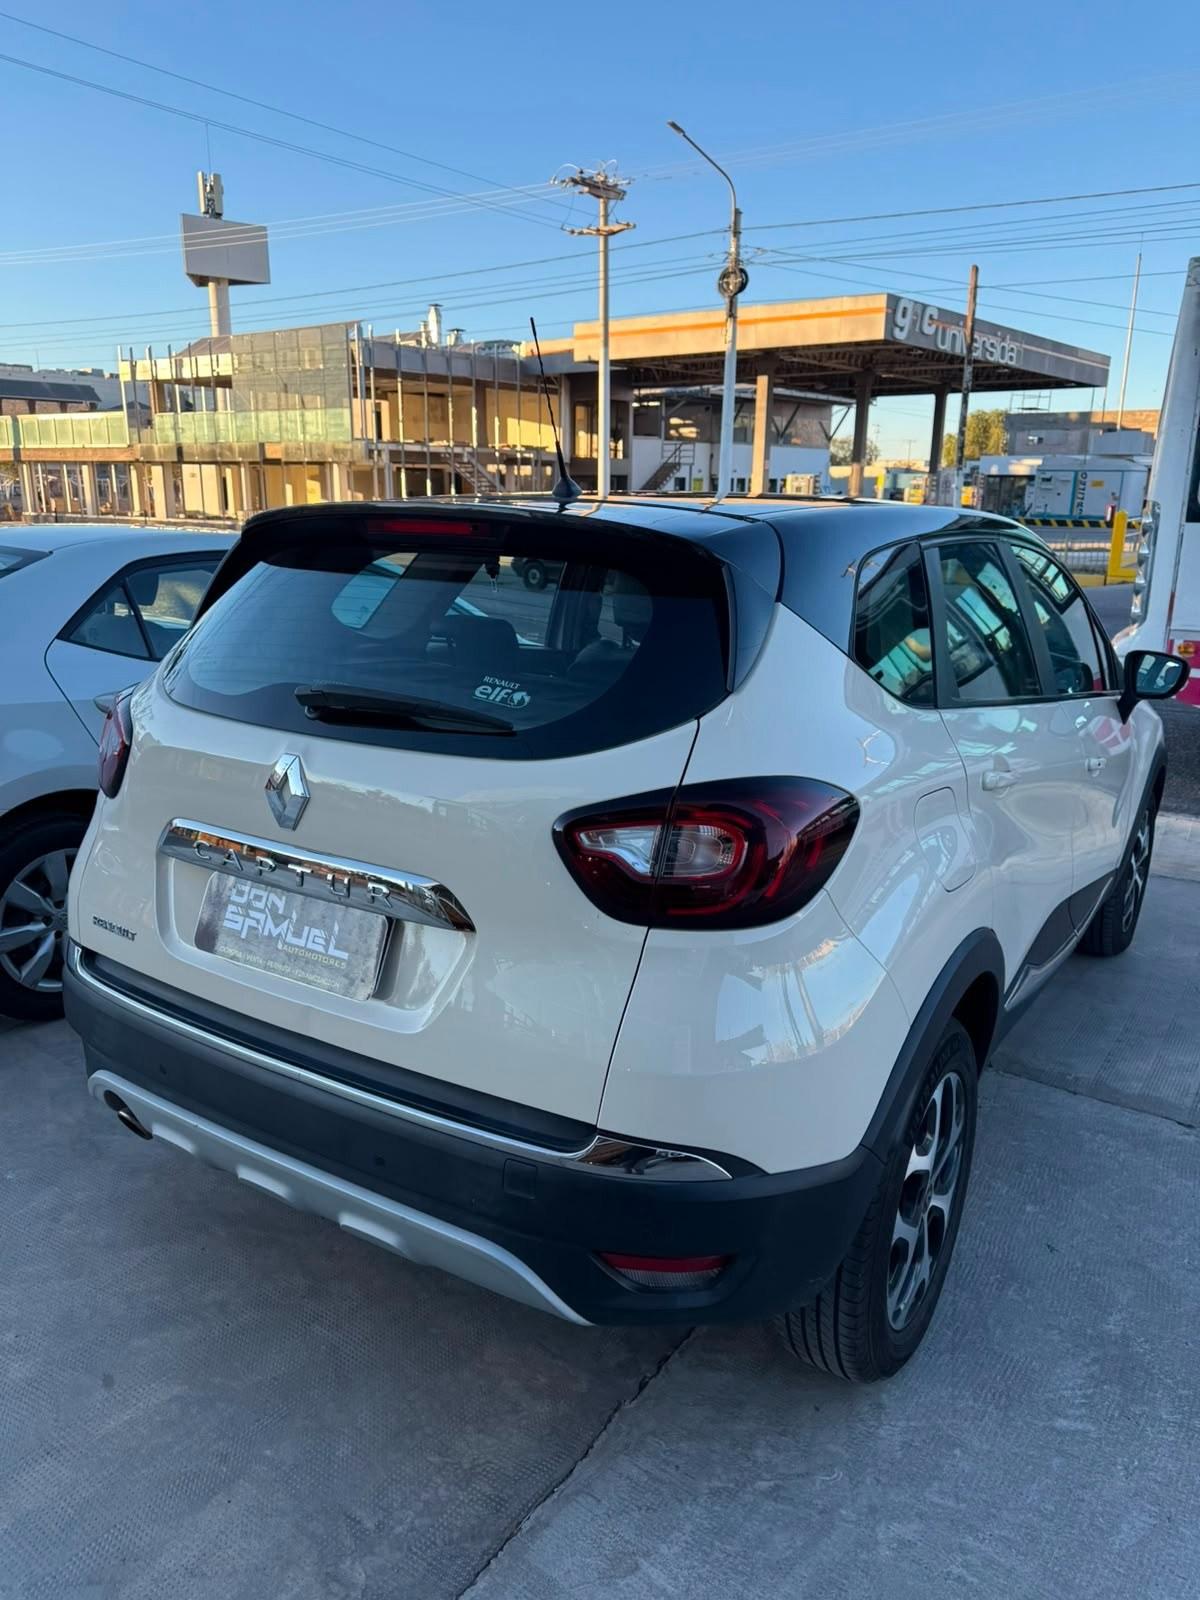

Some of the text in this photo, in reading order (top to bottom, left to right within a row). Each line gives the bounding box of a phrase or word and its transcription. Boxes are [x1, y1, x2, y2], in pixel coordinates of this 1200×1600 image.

[474, 685, 513, 702] elf
[483, 675, 521, 690] RENAULT
[192, 839, 393, 909] CAPTUR
[230, 882, 286, 914] DON
[223, 903, 350, 961] SAMUEL
[283, 946, 347, 970] AUTOMOTORES
